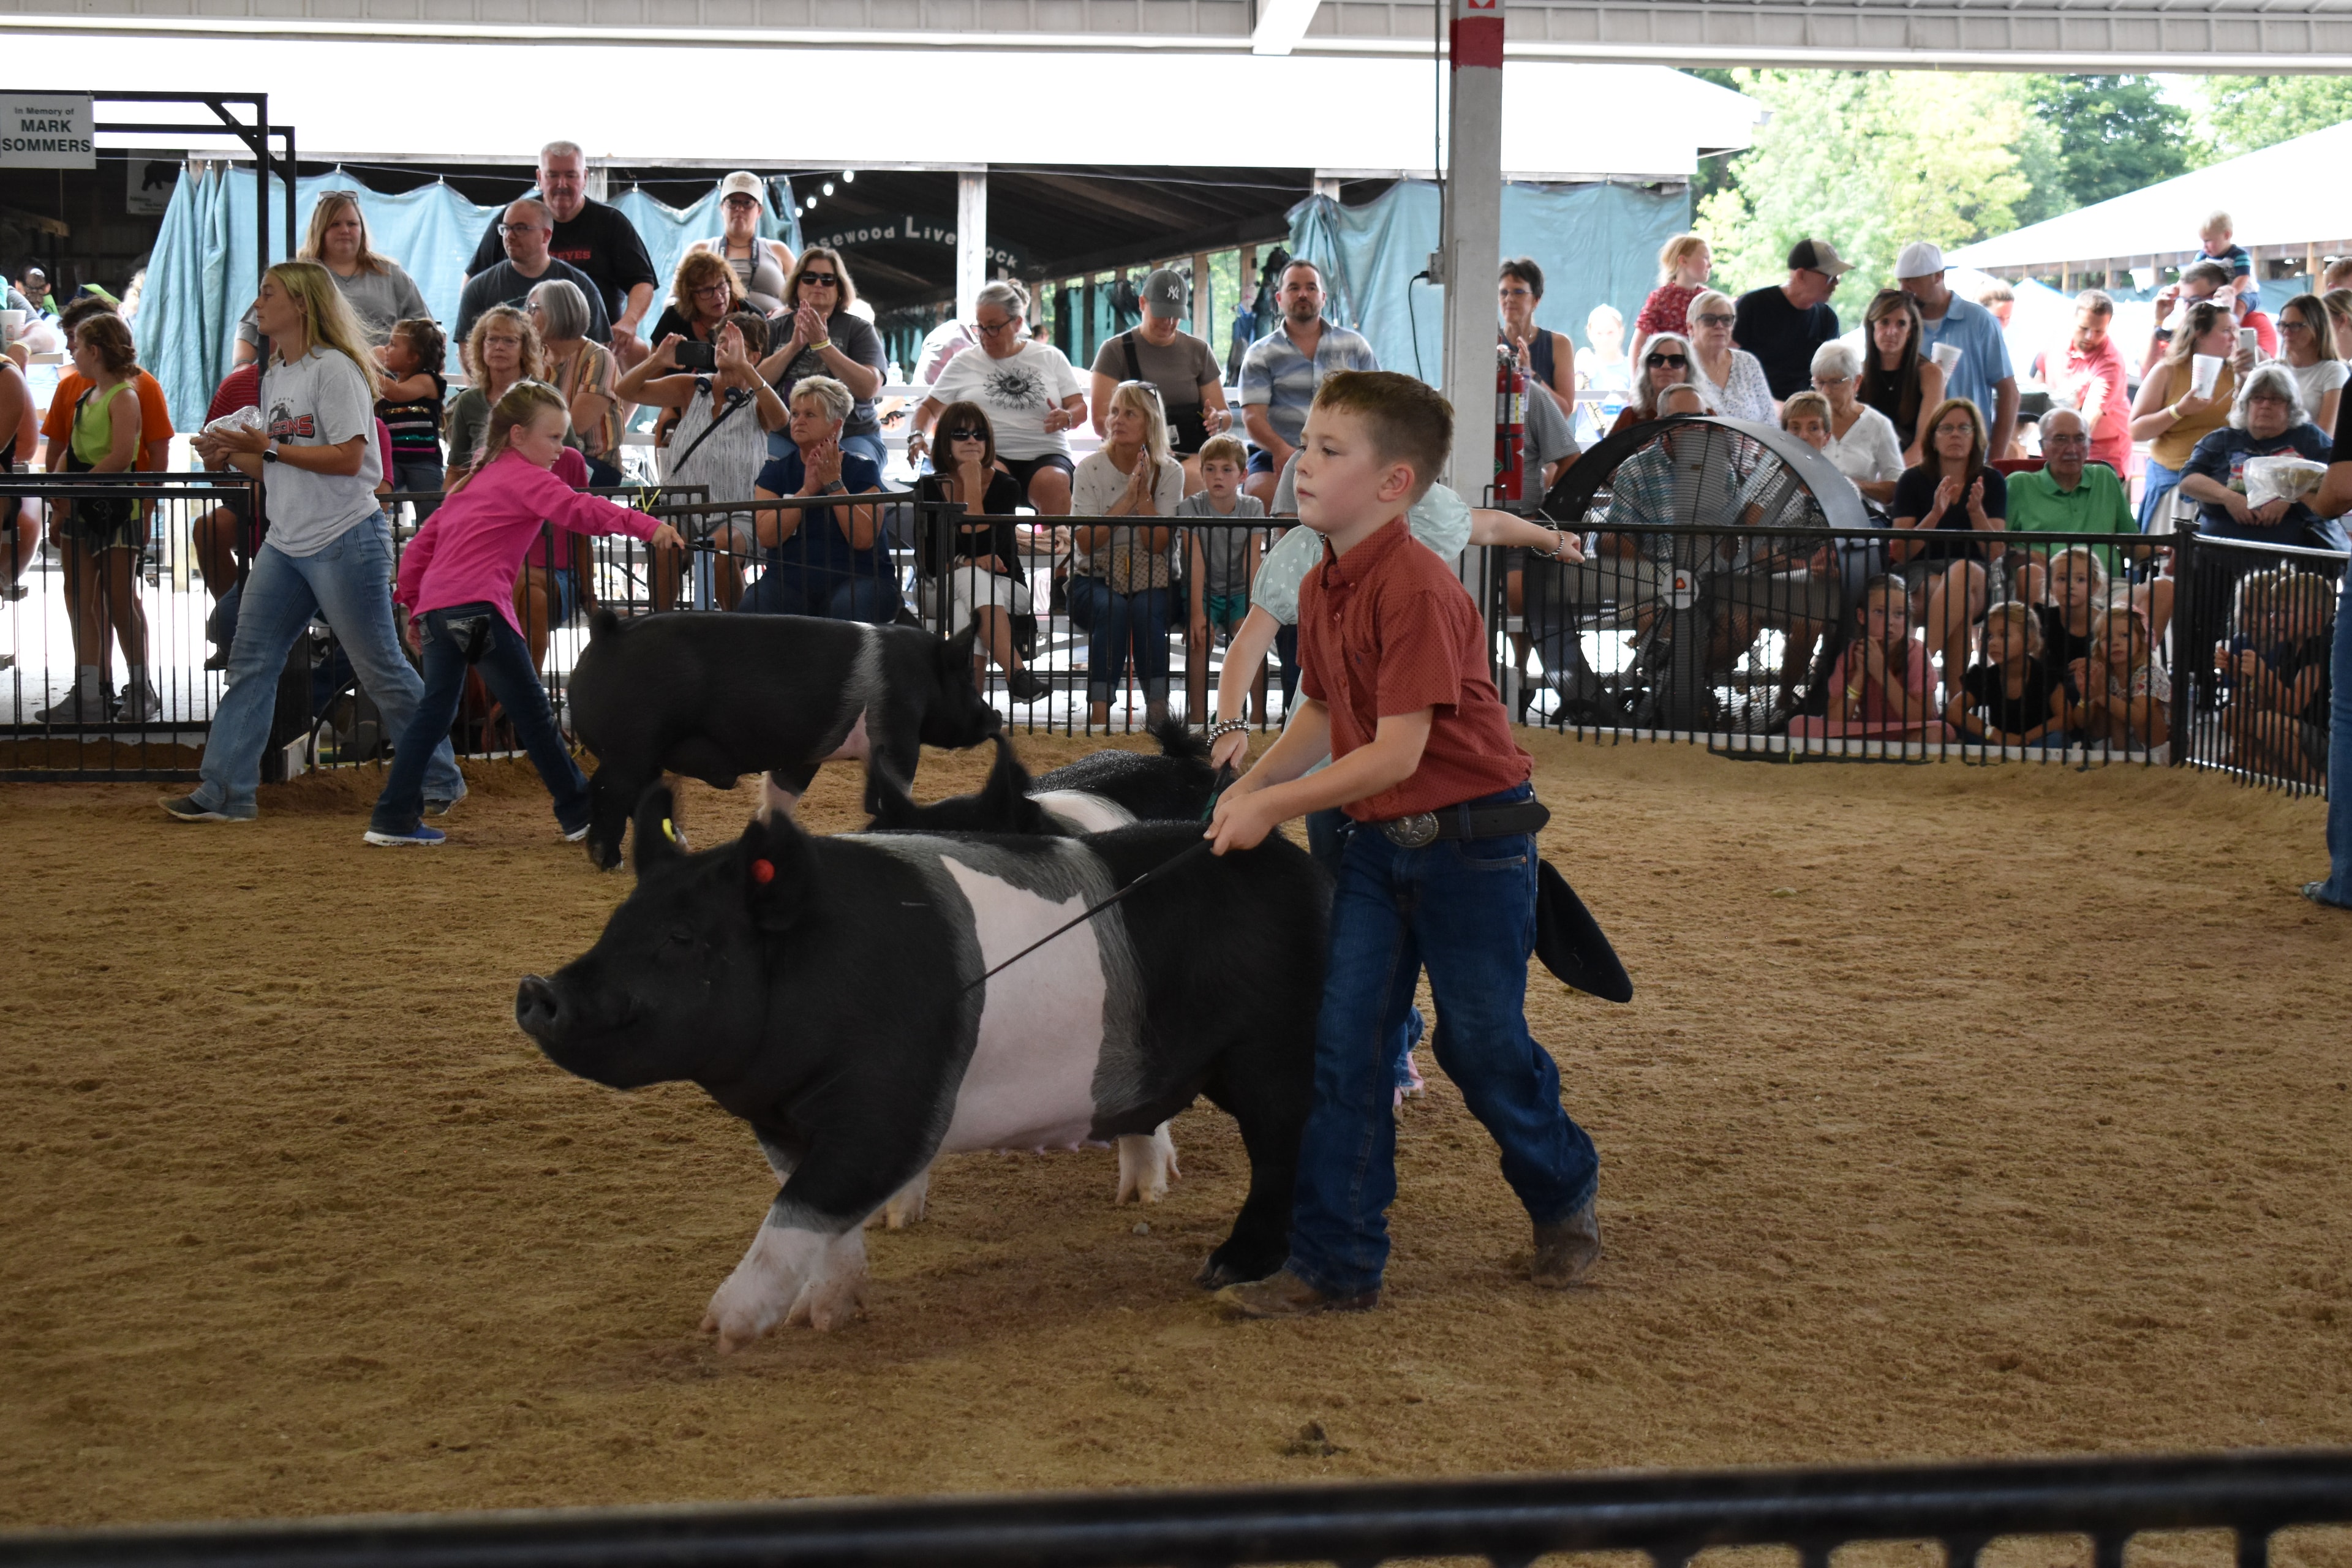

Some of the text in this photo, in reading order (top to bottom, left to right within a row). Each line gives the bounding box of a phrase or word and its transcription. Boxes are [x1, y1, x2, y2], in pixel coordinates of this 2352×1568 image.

[26, 107, 62, 116] Memory
[21, 119, 72, 133] MARK
[2, 138, 91, 153] SOMMERS
[806, 226, 895, 249] sewood
[1167, 285, 1179, 300] NY
[266, 415, 314, 439] LCONS
